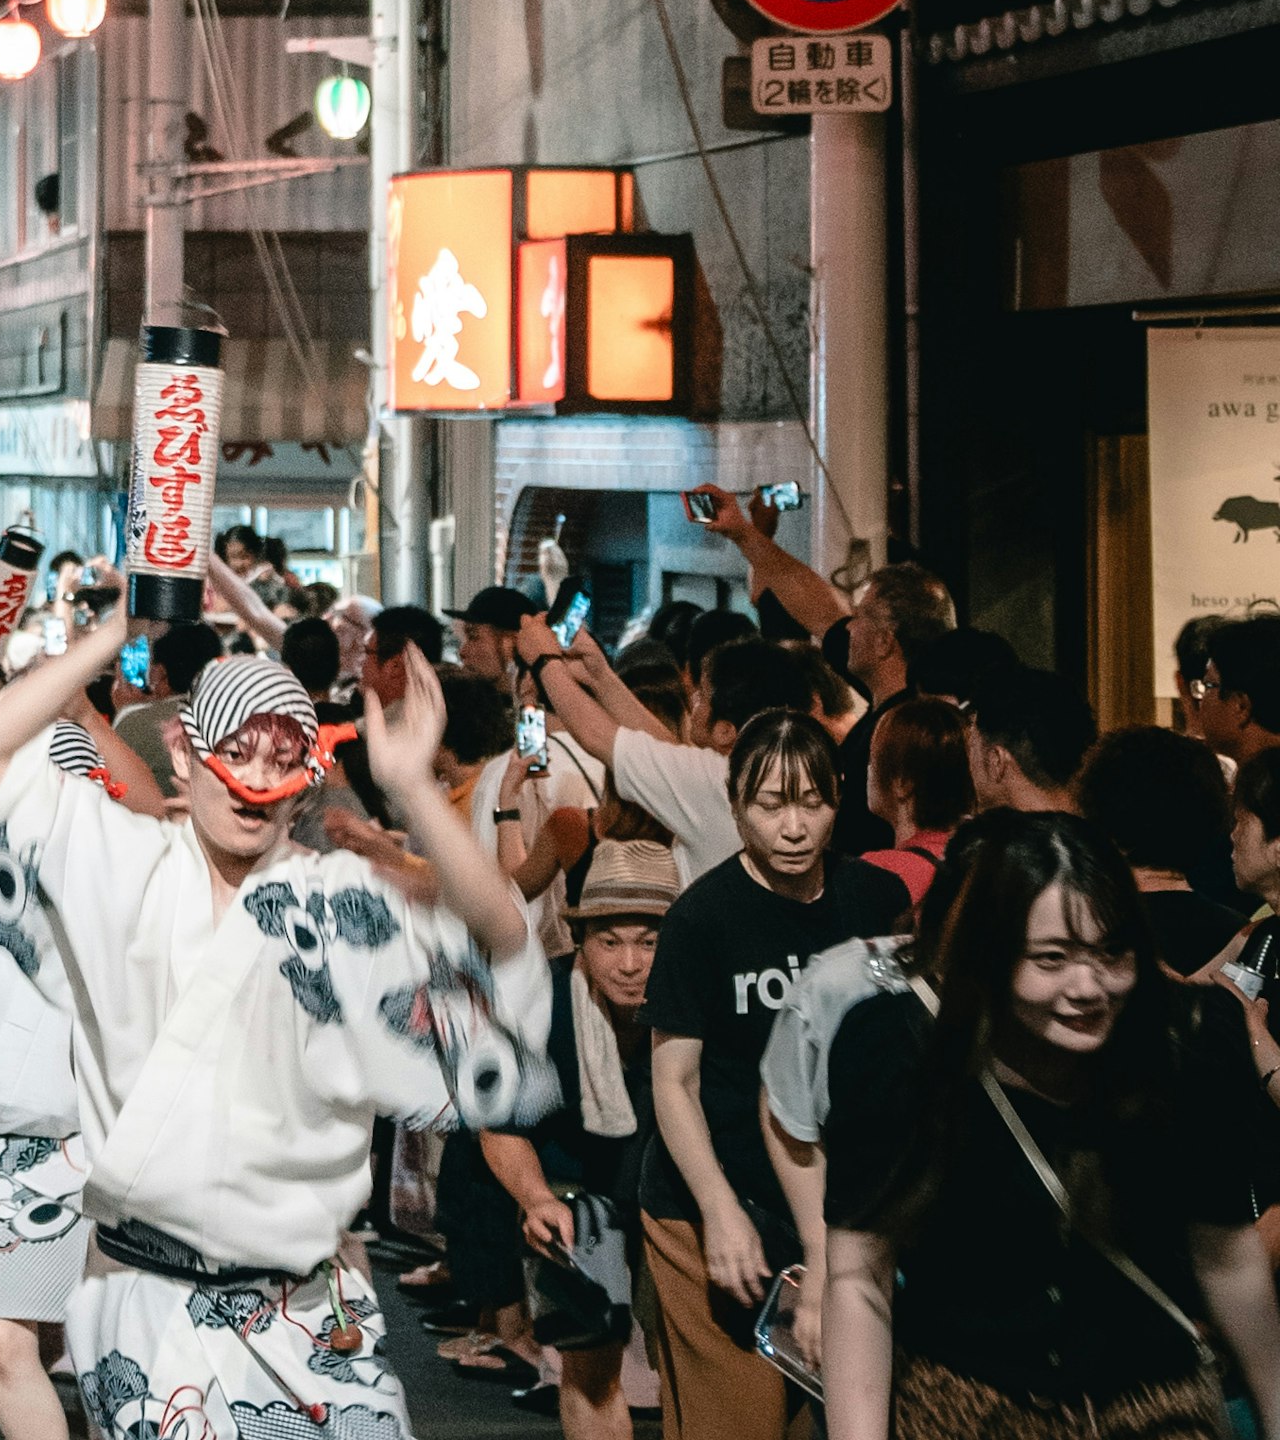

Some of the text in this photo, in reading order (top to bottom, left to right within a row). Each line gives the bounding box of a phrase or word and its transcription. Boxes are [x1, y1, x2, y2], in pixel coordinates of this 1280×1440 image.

[768, 40, 874, 71] 自動車
[757, 75, 888, 106] (2輪を除く)
[1208, 402, 1256, 417] awa
